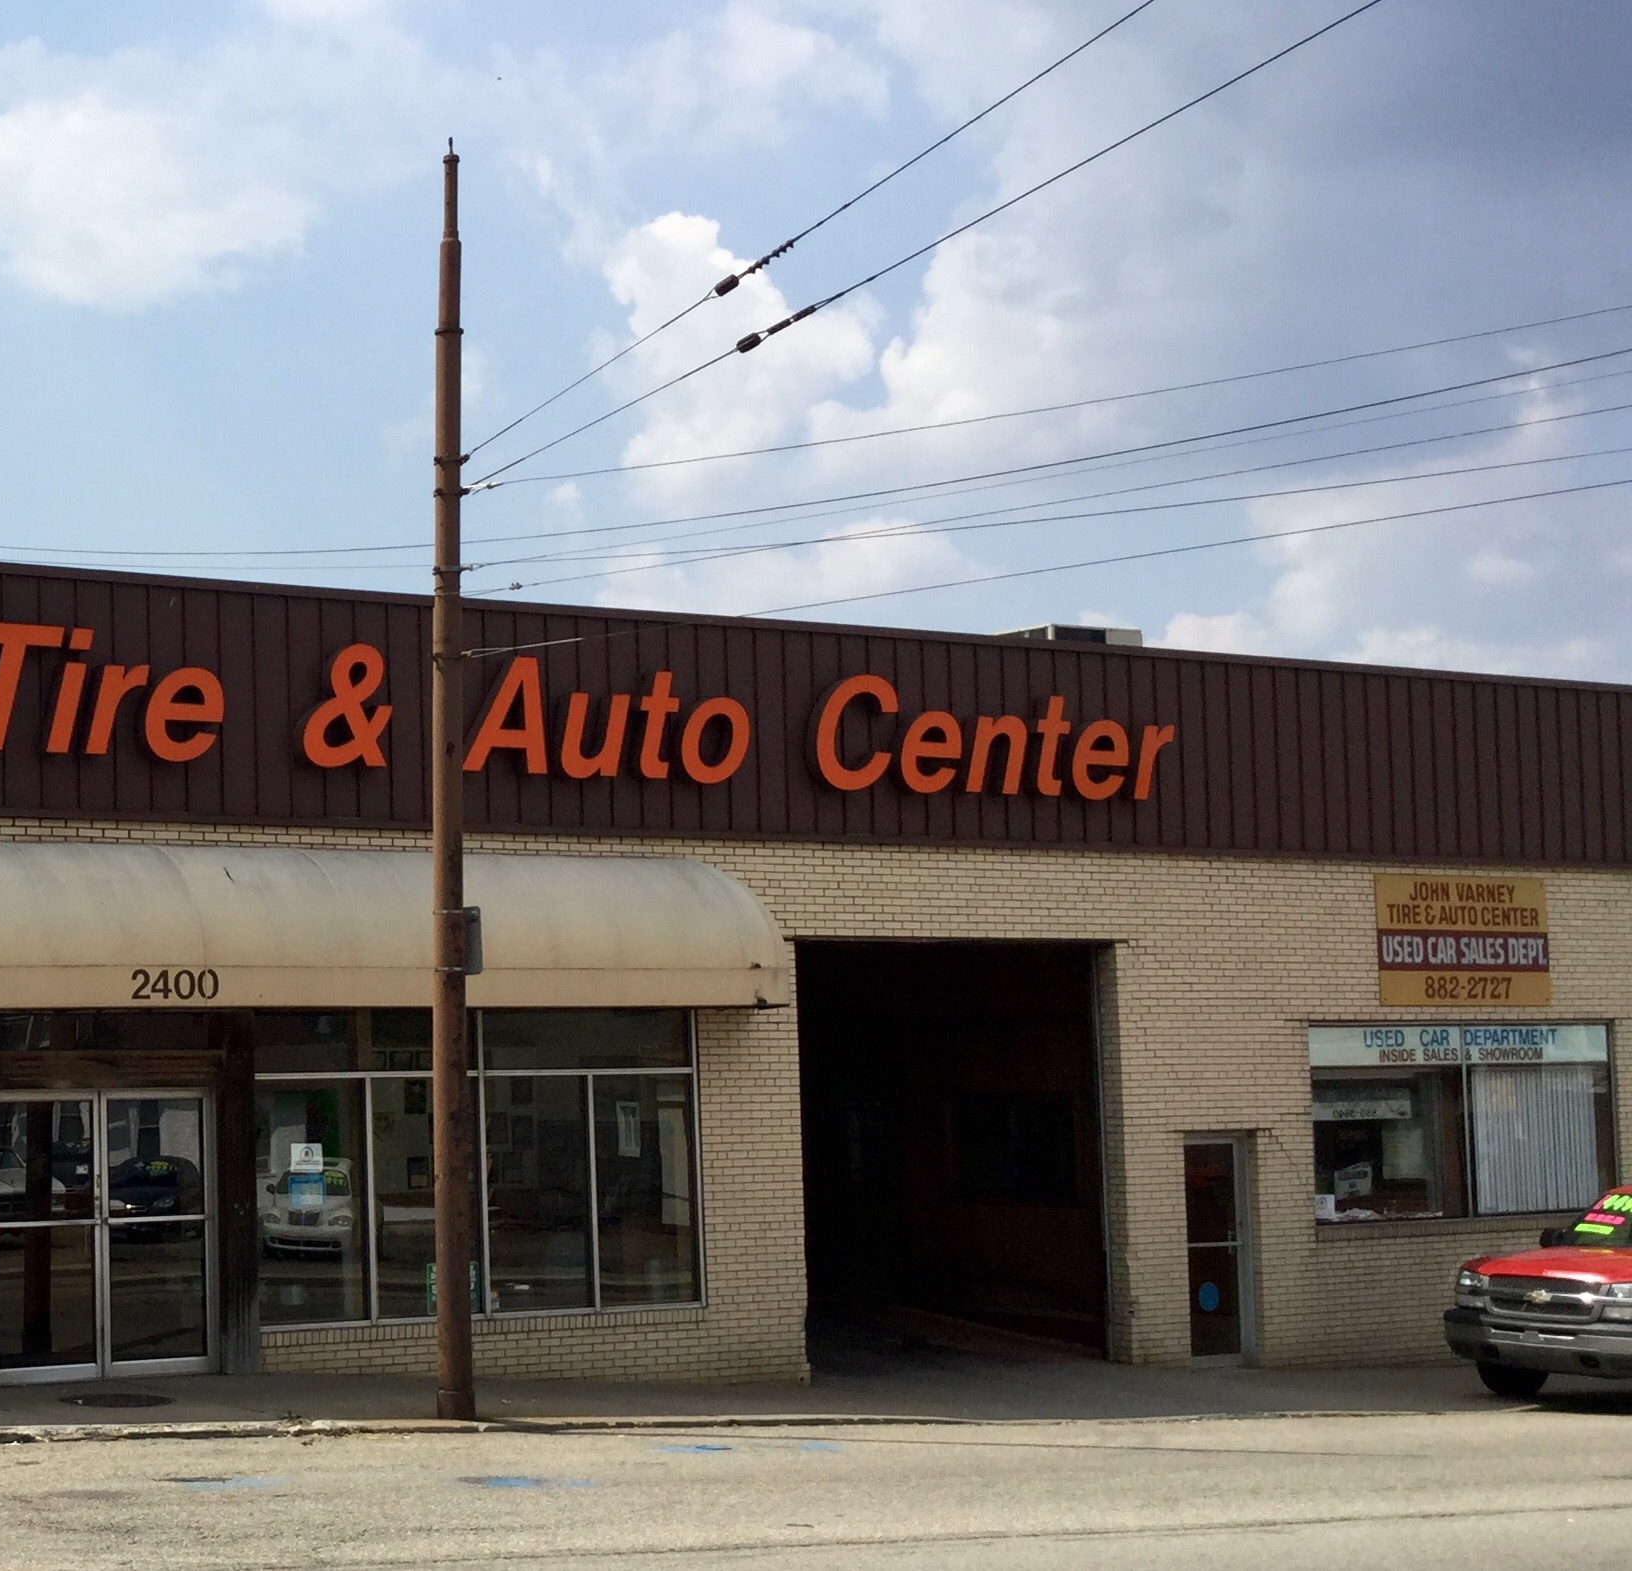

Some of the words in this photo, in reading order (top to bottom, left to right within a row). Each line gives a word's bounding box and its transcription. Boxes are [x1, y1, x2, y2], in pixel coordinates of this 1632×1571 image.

[303, 643, 393, 767] &
[463, 656, 750, 784] Auto
[816, 675, 1176, 800] Center
[1409, 881, 1450, 902] JOHN
[1455, 883, 1515, 904] VARNEY
[1386, 903, 1421, 925] TIRE
[1424, 905, 1436, 926] &
[1438, 906, 1478, 927] AUTO
[1481, 907, 1539, 927] CENTER
[1382, 935, 1424, 964] USED
[1427, 936, 1458, 965] CAR
[1459, 937, 1505, 965] SALES
[1507, 938, 1547, 966] DEPT.
[131, 968, 219, 1000] 2400
[1424, 975, 1513, 1000] 882-2727
[1363, 1029, 1405, 1048] USED
[1419, 1029, 1451, 1046] CAR
[1463, 1028, 1558, 1046] DEPARTMENT
[1379, 1049, 1416, 1062] INSIDE
[1423, 1048, 1459, 1062] SALES
[1478, 1048, 1544, 1061] SHOWROOM
